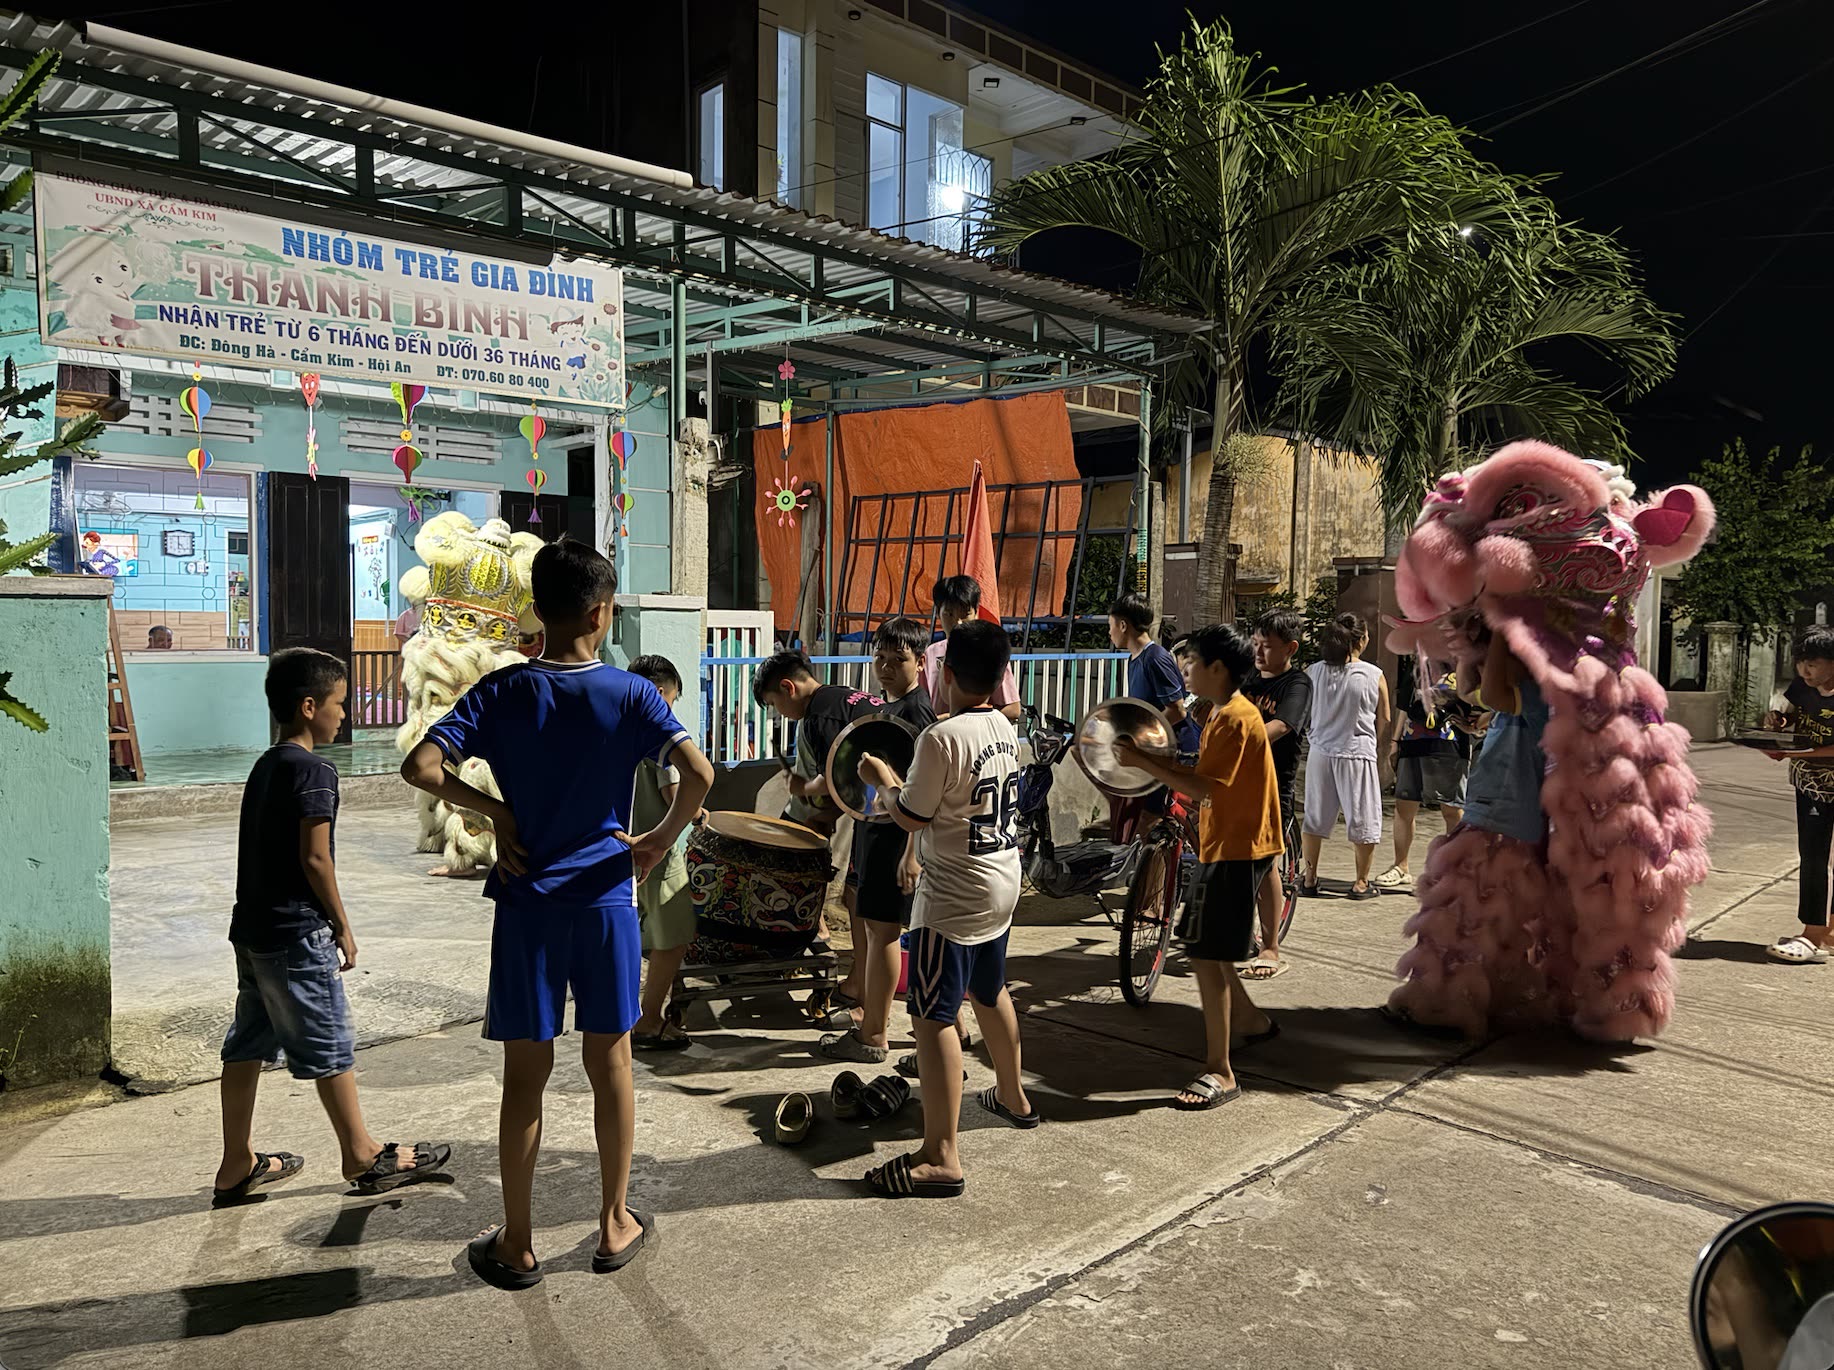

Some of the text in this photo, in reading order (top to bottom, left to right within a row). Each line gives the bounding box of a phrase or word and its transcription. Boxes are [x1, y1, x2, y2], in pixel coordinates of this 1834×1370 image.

[95, 192, 134, 208] UBND
[137, 199, 155, 211] XÃ
[191, 209, 217, 222] KIM
[281, 230, 594, 303] NHÓM TRẺ GIA ĐÌNH
[185, 254, 529, 341] THANH BÌNH
[159, 304, 561, 371] NHẬN TRẺ TỪ 6 THÁNG ĐẾN DƯỚI 36 THÁNG
[179, 334, 206, 350] ĐC:
[211, 338, 251, 359] Đông
[255, 343, 276, 359] Hà
[327, 353, 355, 368] Kim
[367, 357, 391, 374] Hội
[394, 360, 412, 374] An
[436, 365, 458, 379] ĐT:
[461, 368, 505, 384] 070.60
[508, 374, 524, 386] 80
[527, 376, 550, 389] 400
[969, 741, 1015, 777] YOUNG BOYS
